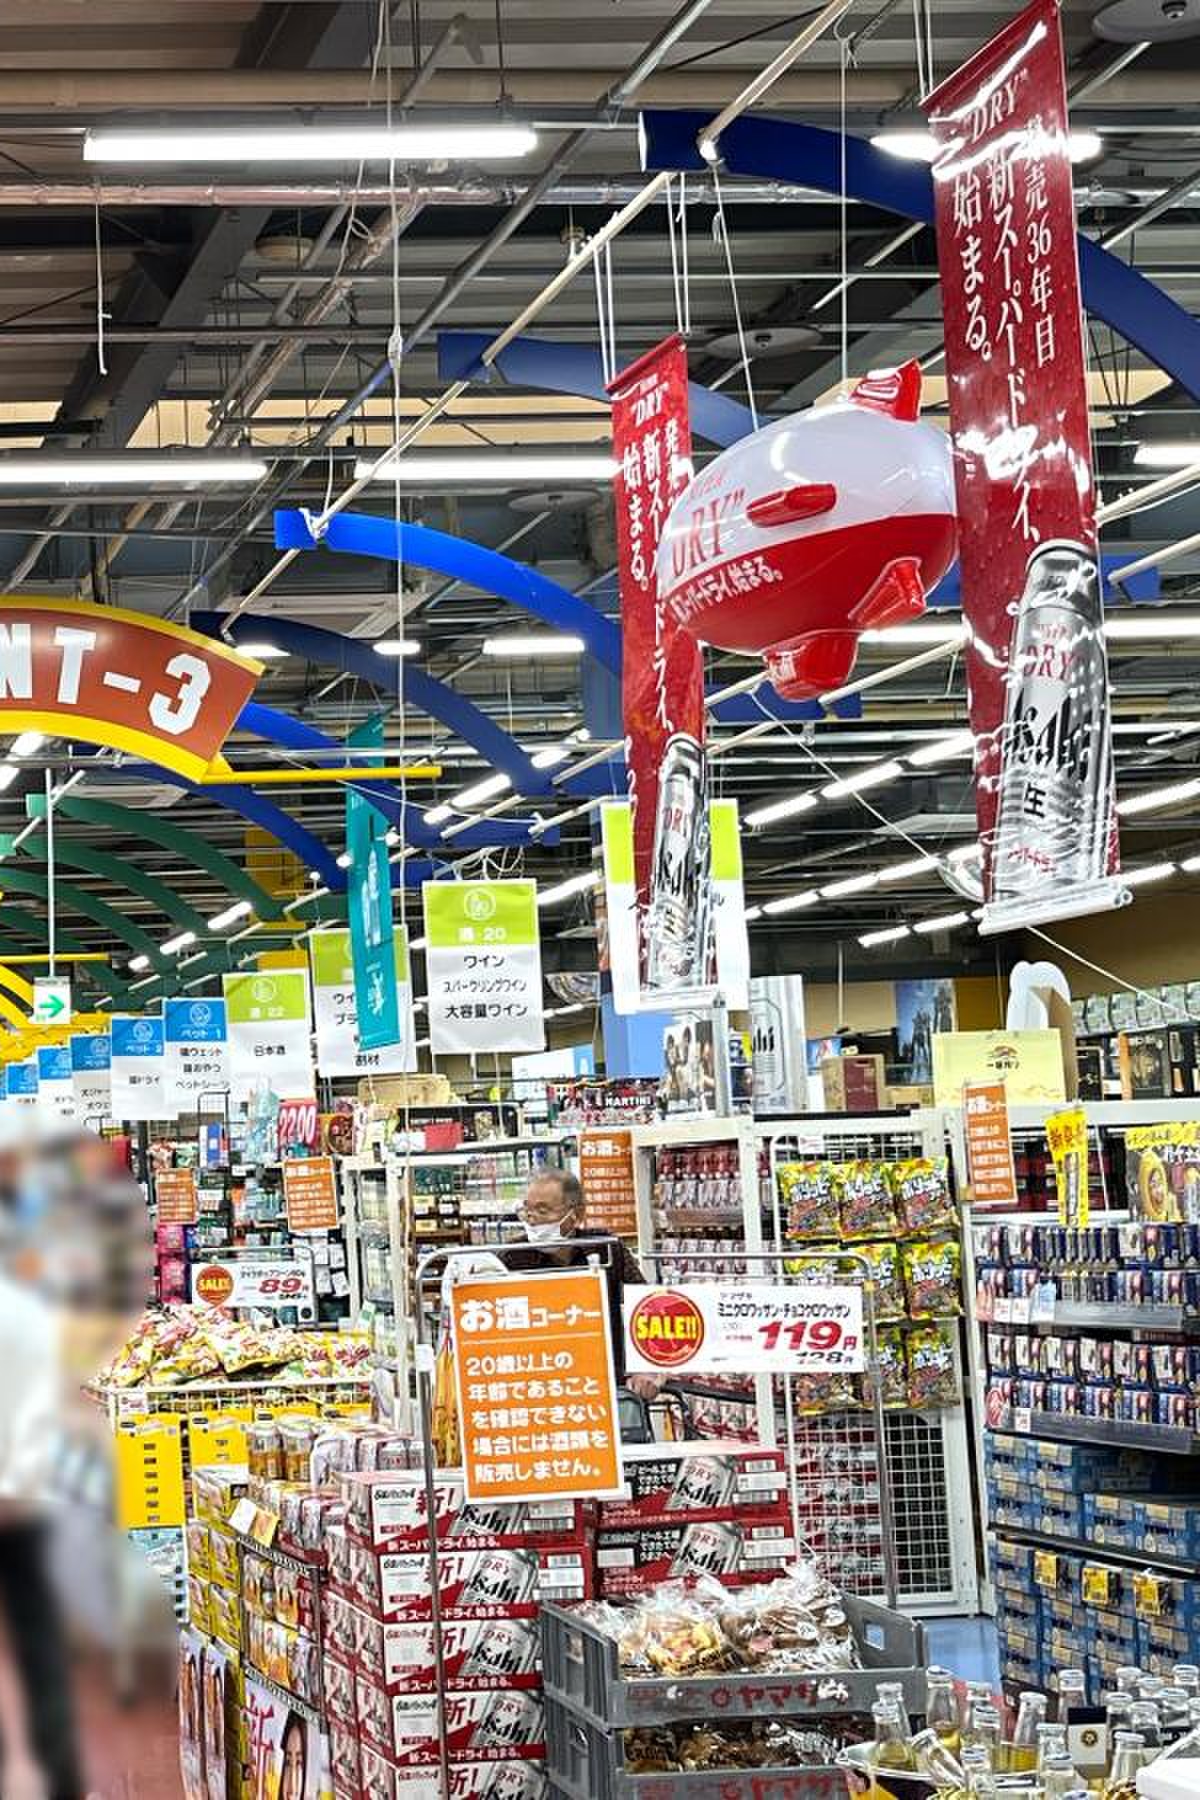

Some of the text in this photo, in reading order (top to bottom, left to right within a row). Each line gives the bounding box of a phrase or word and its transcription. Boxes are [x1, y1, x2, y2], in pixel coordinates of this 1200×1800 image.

[953, 167, 993, 362] 始まる。
[623, 441, 649, 592] 始まる。
[464, 955, 506, 970] ワイン
[445, 1004, 529, 1020] 大容量ワイン
[254, 1044, 287, 1057] 日本酒
[460, 1296, 602, 1332] お酒コーナー
[465, 1351, 574, 1376] 20歳以上の
[467, 1377, 601, 1402] 年齢であること
[471, 1404, 607, 1429] を確認できない
[473, 1430, 609, 1456] 場合には酒類を
[475, 1459, 601, 1484] 販売しません。
[387, 1536, 501, 1551] 新スーパドライ、始まる。
